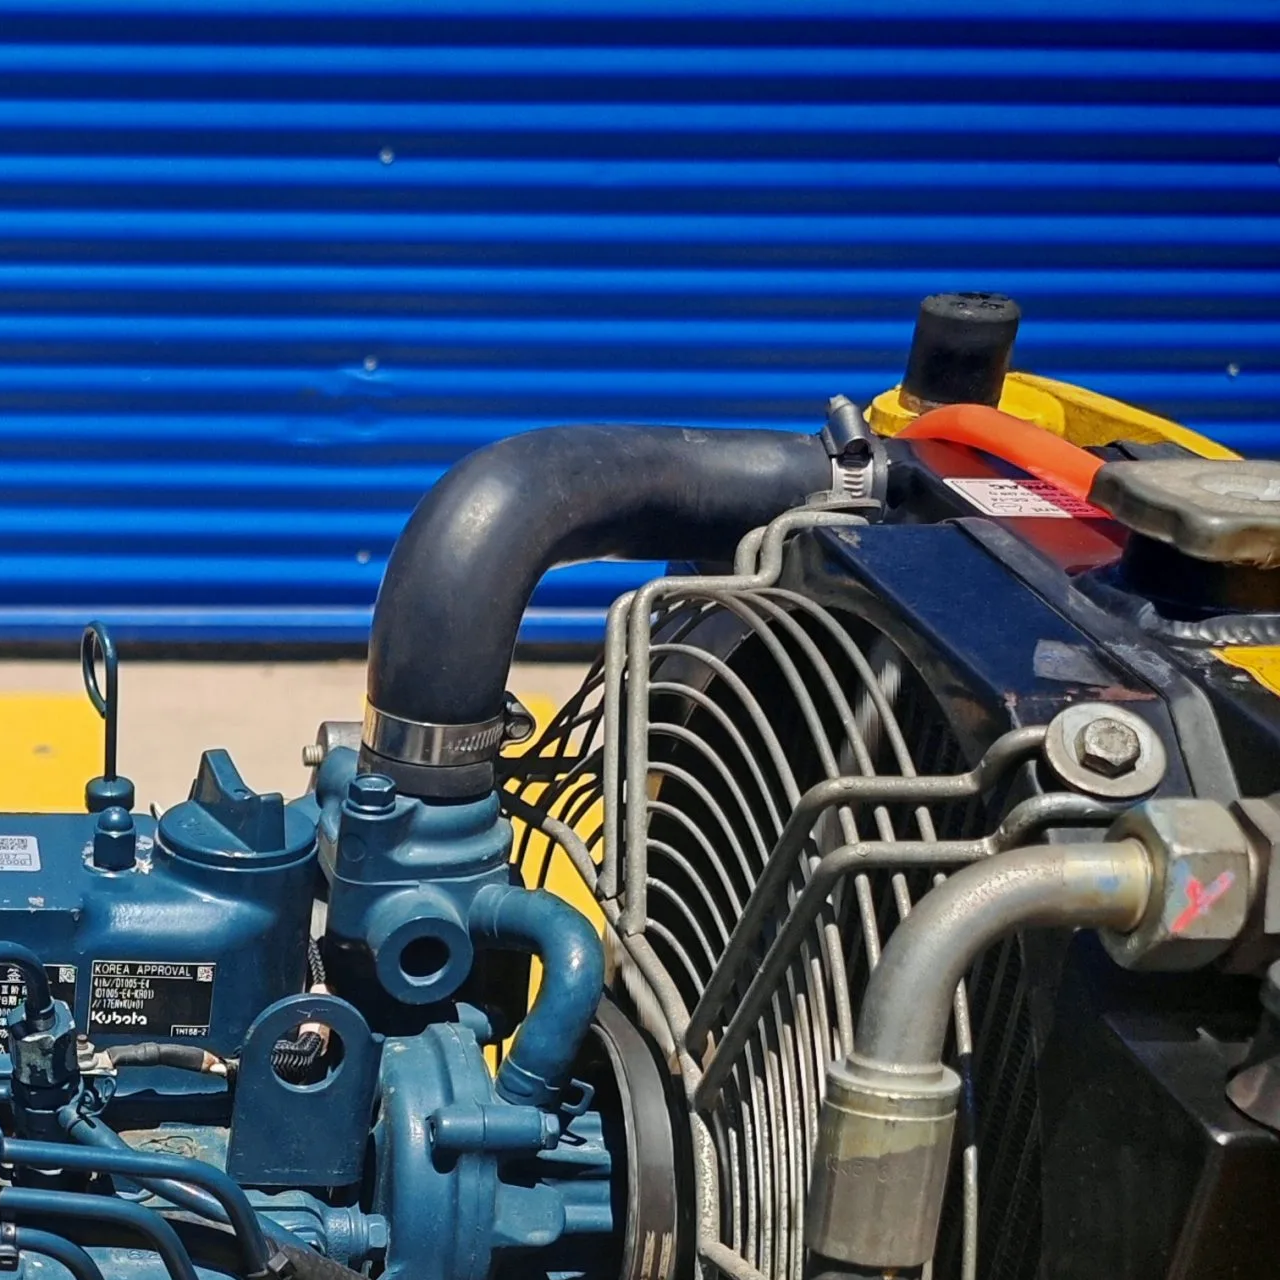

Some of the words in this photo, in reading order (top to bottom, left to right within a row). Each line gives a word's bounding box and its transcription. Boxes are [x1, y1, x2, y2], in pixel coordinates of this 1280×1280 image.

[94, 963, 130, 975] KOREA
[136, 965, 191, 977] APPROVAL
[91, 1011, 148, 1025] Kubota
